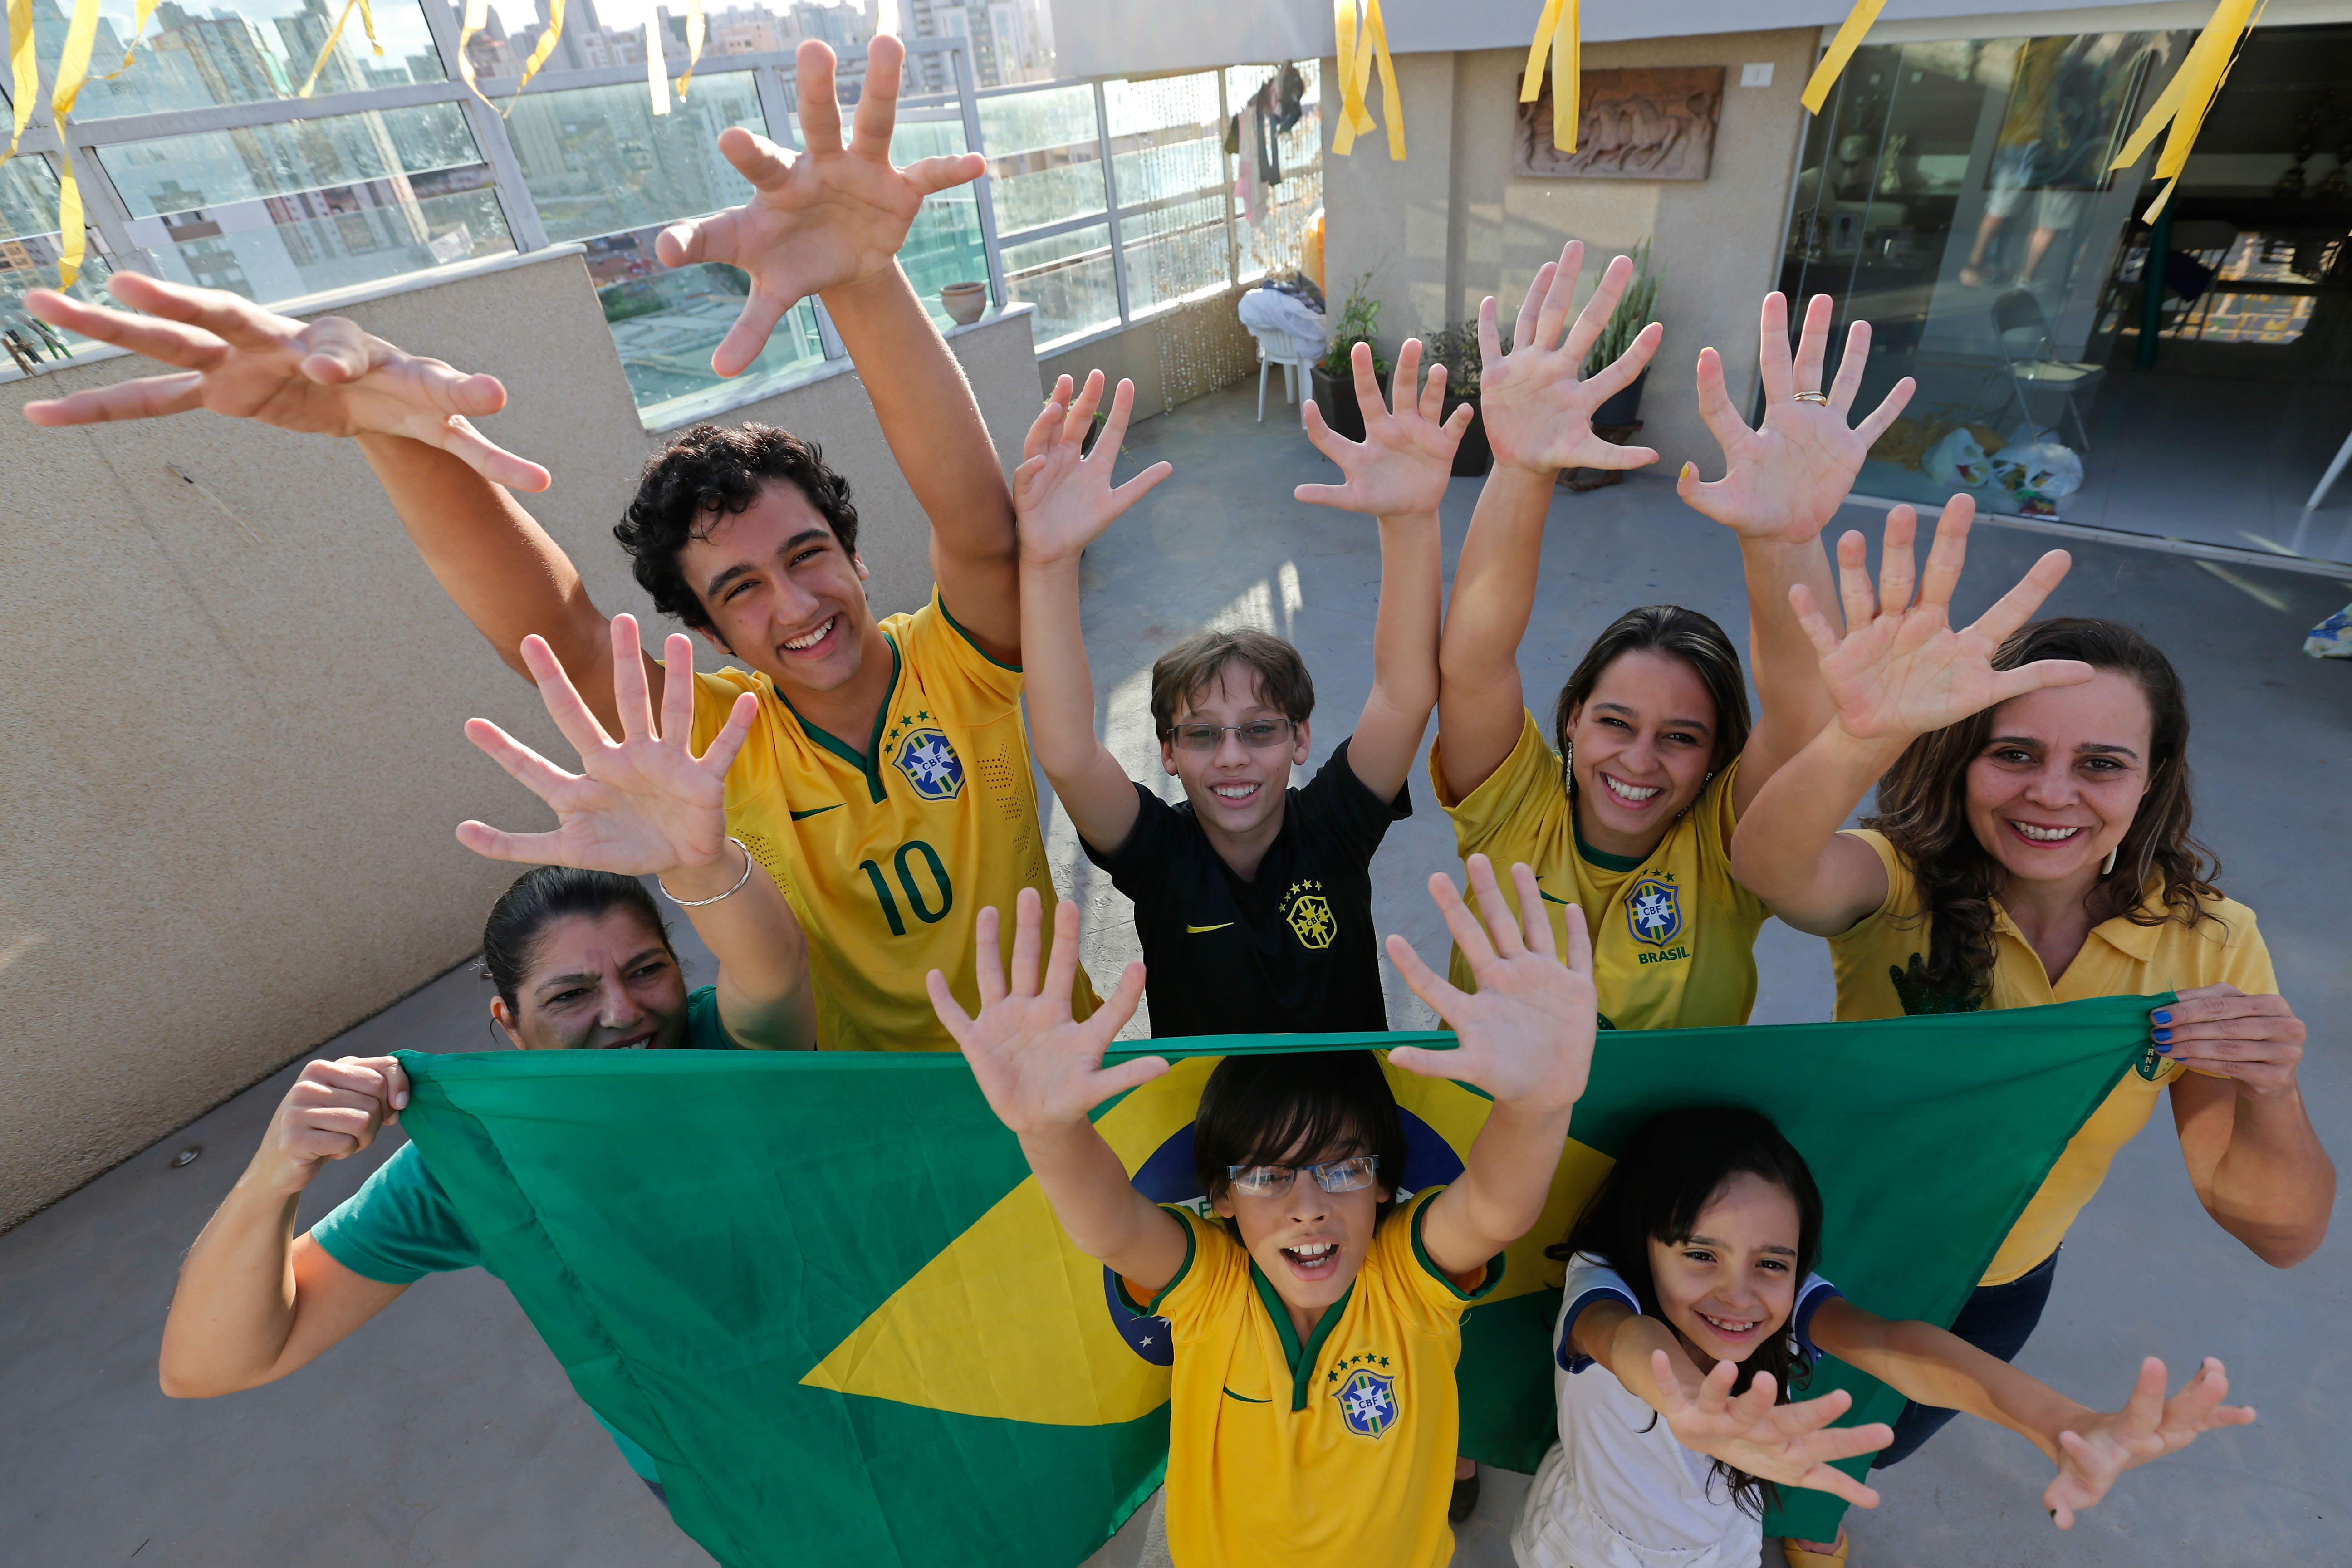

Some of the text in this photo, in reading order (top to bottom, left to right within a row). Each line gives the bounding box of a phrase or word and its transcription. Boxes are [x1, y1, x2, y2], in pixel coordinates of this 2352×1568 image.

[922, 754, 942, 770] CBF
[859, 840, 953, 936] 10
[1643, 905, 1661, 915] CBF
[1306, 914, 1321, 927] CBF
[1638, 946, 1690, 964] BRASIL
[2143, 1044, 2155, 1072] RNG
[1358, 1396, 1378, 1409] CBF
